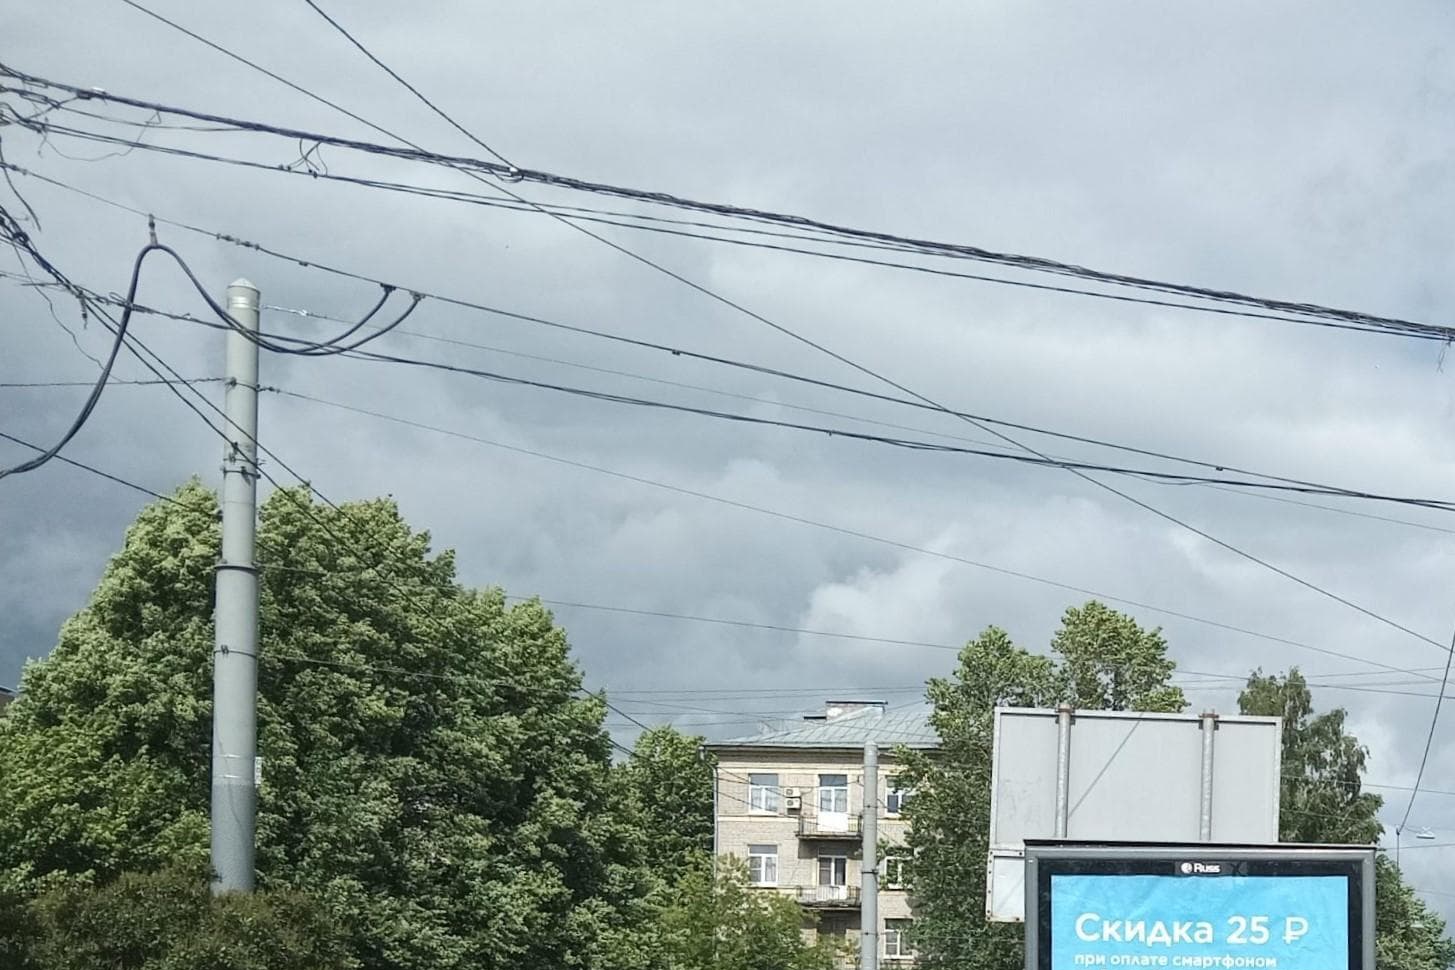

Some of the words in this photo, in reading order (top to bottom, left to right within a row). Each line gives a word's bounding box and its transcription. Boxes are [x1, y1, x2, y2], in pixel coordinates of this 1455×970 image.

[1193, 863, 1220, 873] Russ
[1075, 912, 1214, 948] Скидка
[1226, 915, 1270, 945] 25
[1074, 954, 1106, 968] при
[1110, 955, 1168, 967] оплате
[1172, 953, 1277, 969] смартфоном
